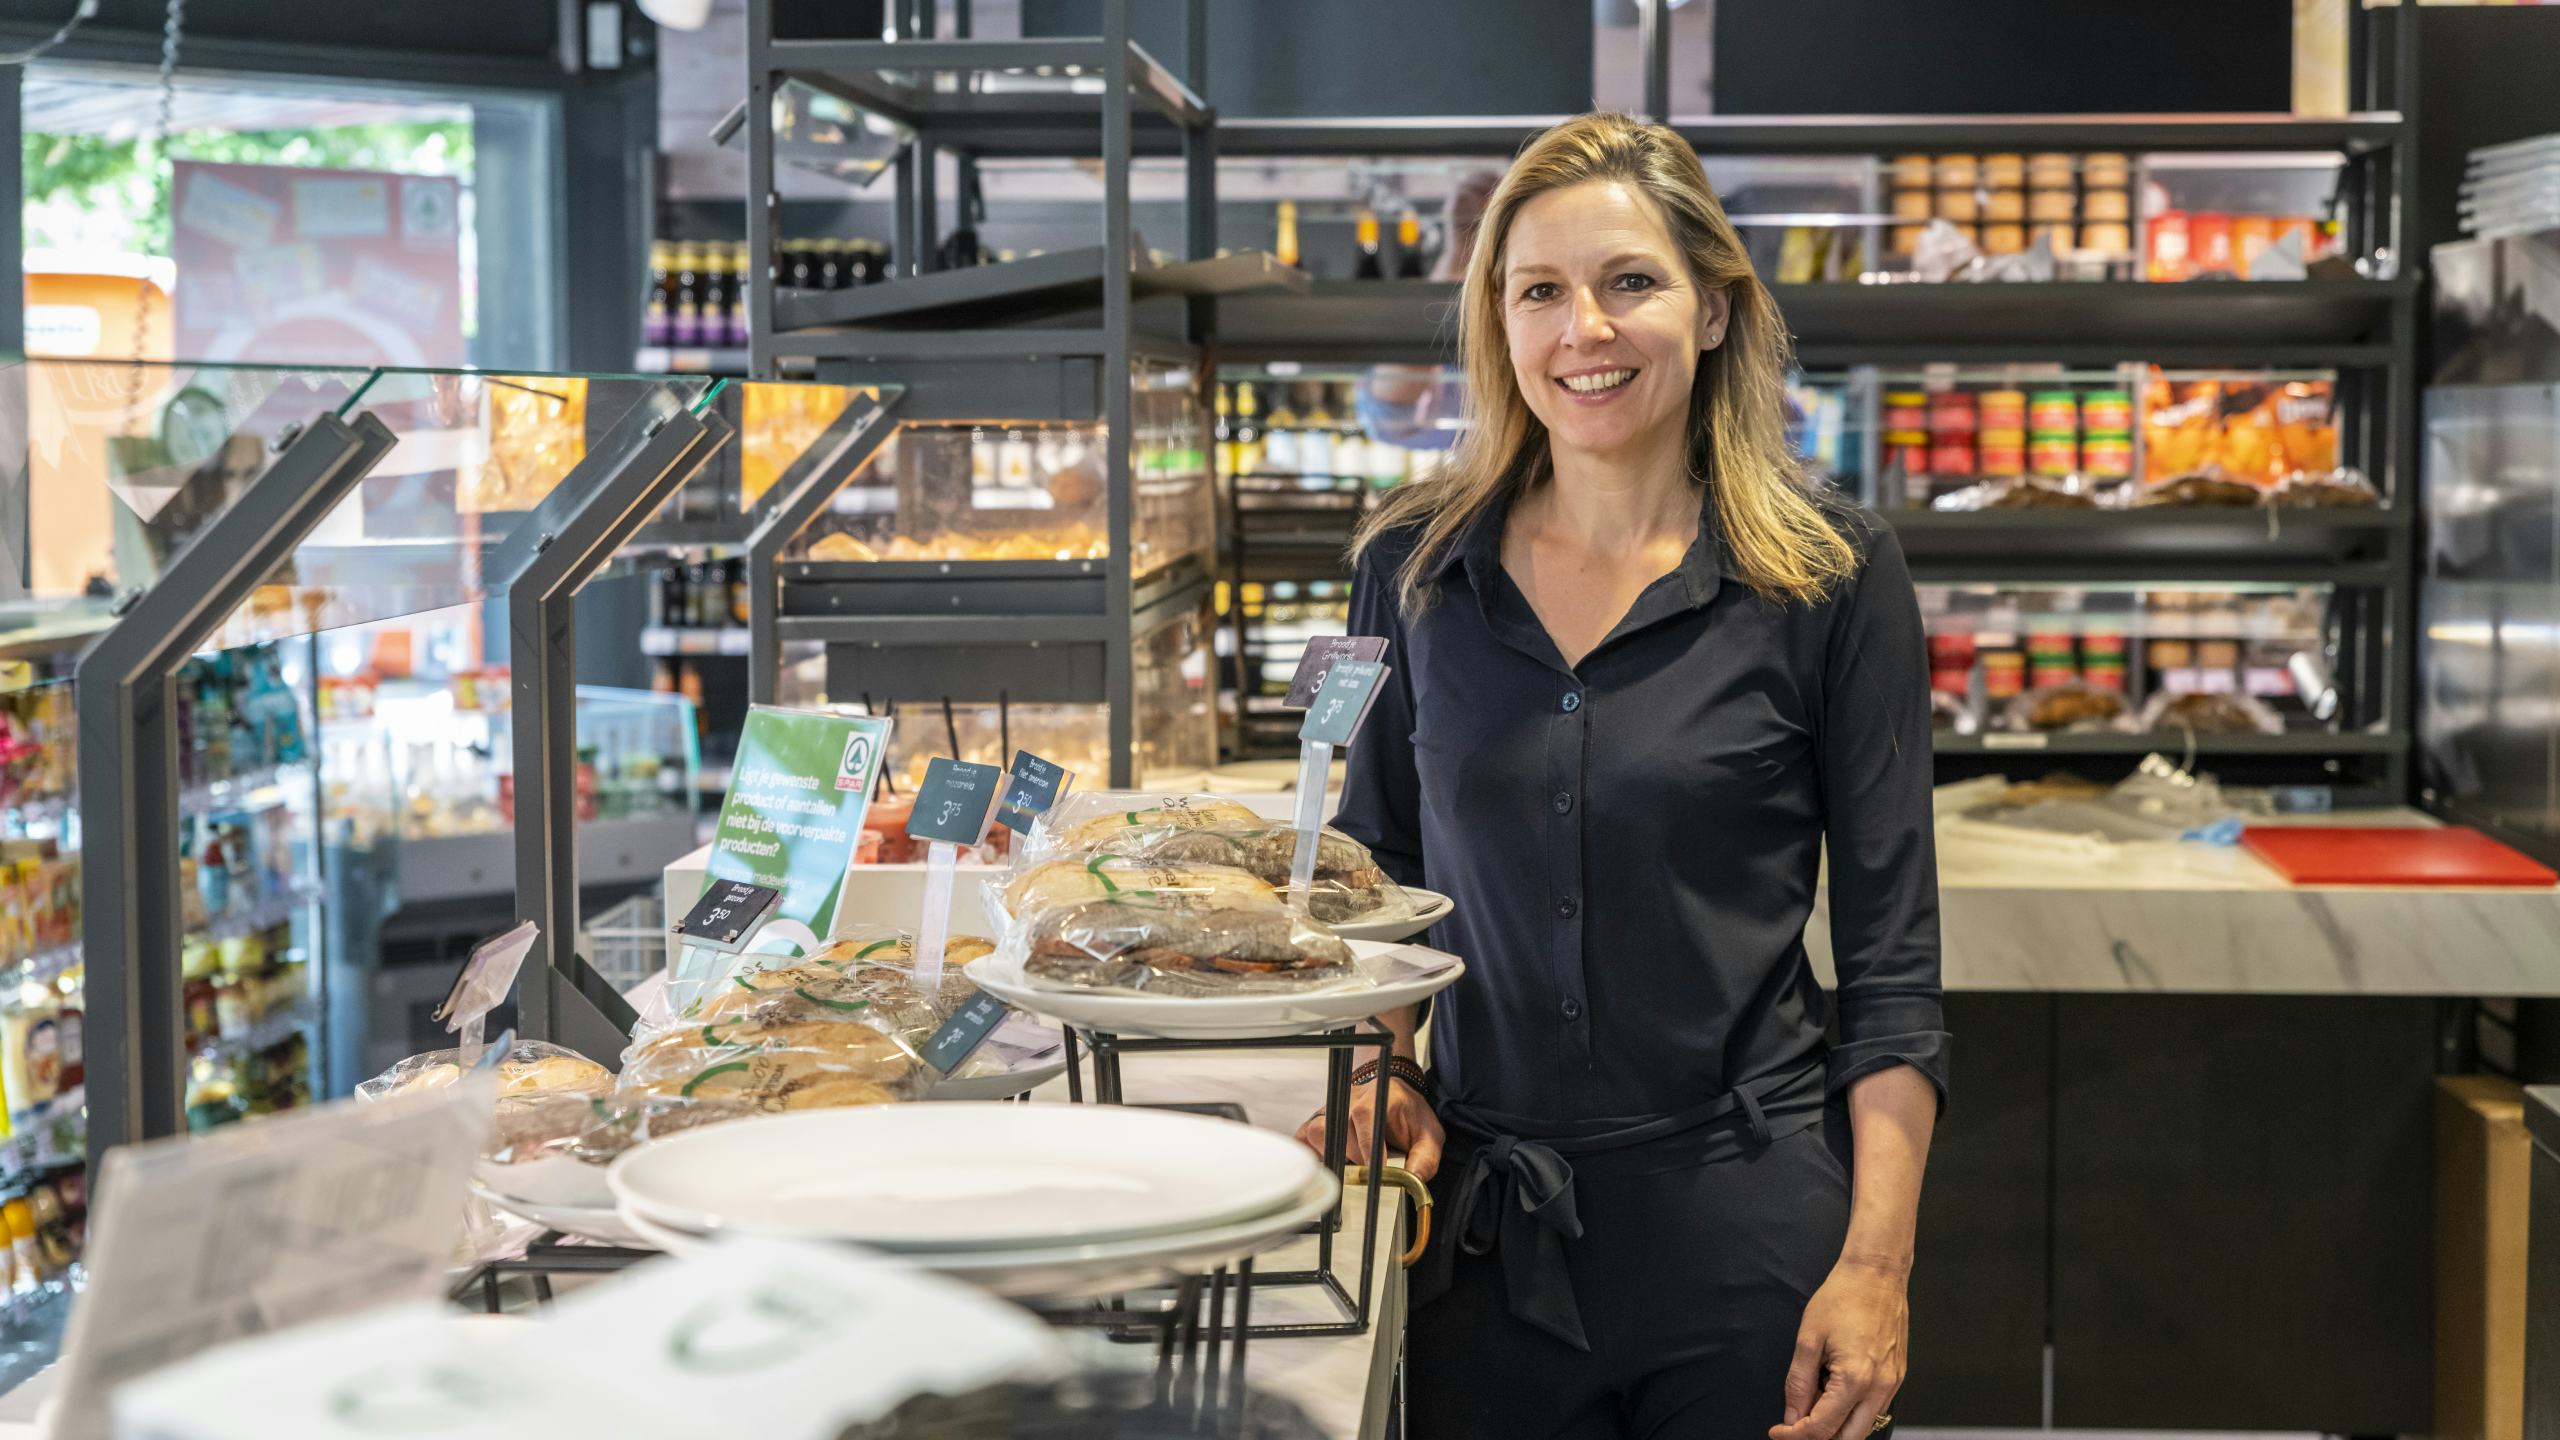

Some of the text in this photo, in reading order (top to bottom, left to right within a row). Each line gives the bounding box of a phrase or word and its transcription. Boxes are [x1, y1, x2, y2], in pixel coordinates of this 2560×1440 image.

[768, 772, 820, 790] gewenste
[836, 777, 863, 791] SPAR
[731, 792, 837, 817] product of aantallen
[726, 812, 847, 843] niet bij de voorverpakte
[719, 837, 781, 858] producten?
